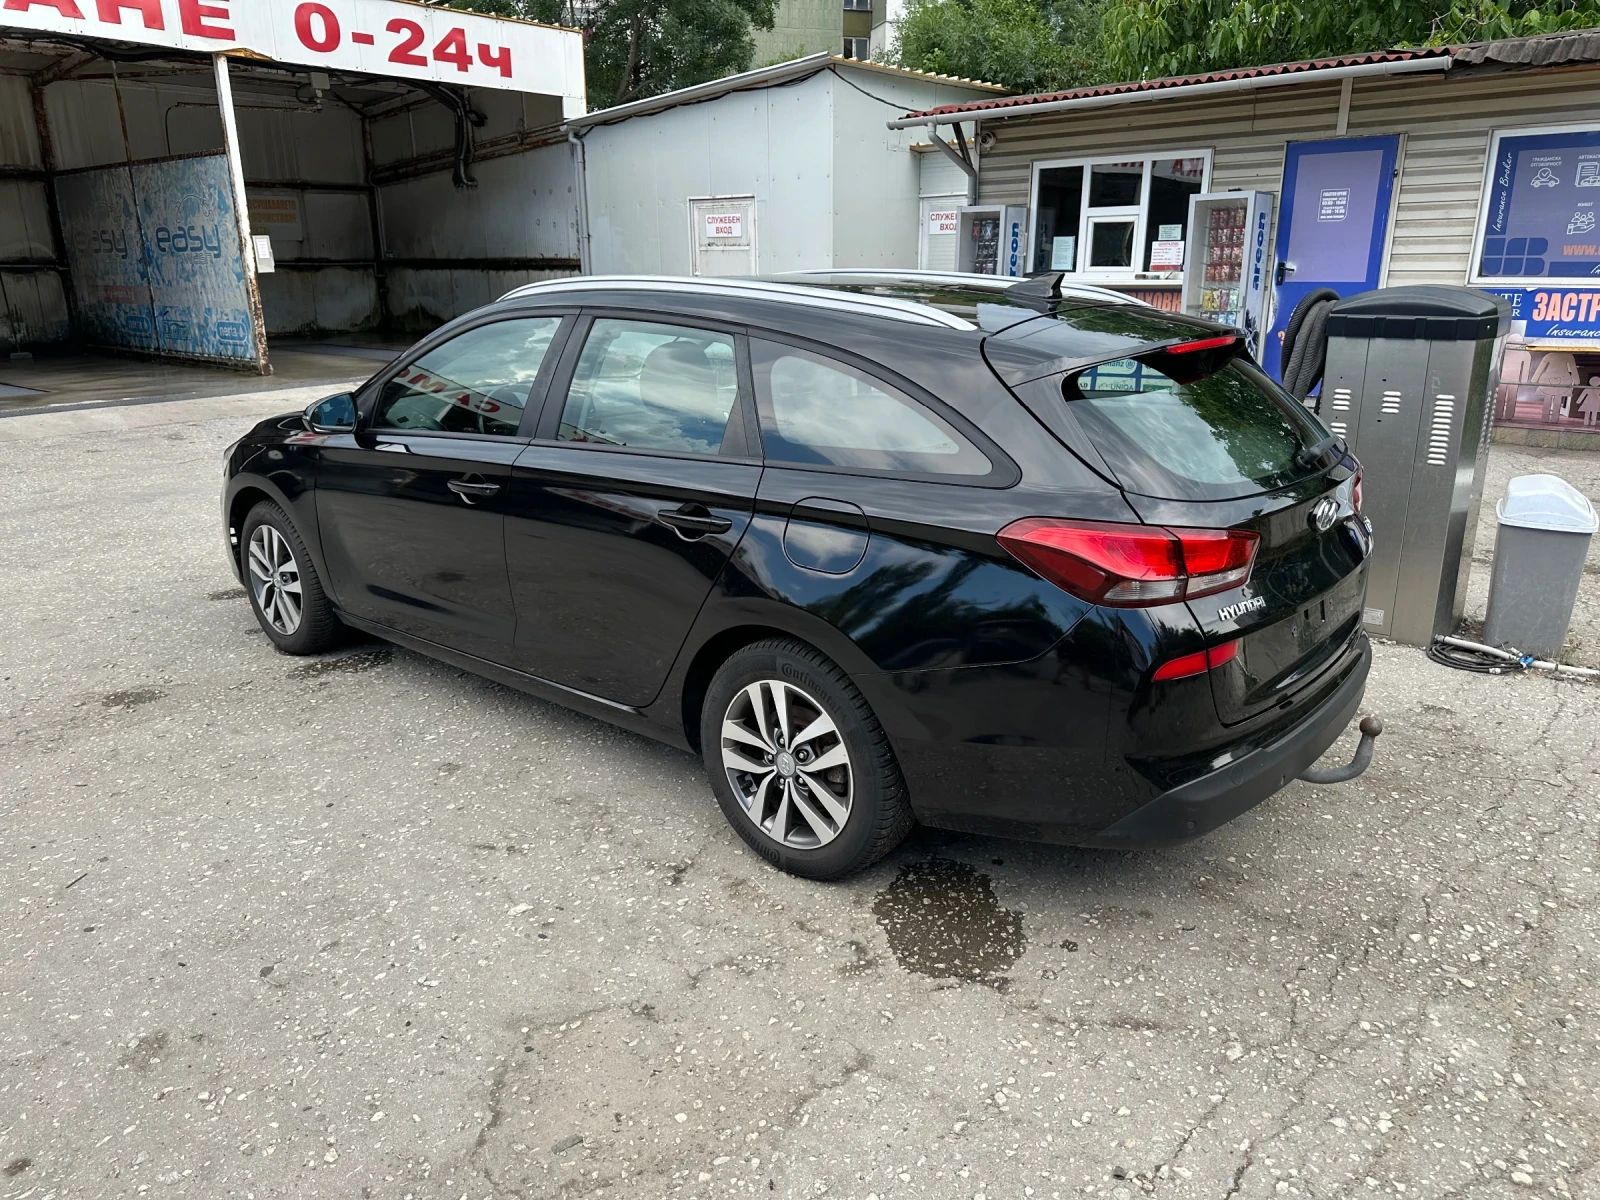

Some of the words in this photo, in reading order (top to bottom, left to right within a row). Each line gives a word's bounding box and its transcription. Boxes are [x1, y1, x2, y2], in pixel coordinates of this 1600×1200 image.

[1492, 190, 1506, 232] Insurance
[1499, 152, 1513, 187] Broker
[707, 216, 740, 224] СЛУЖЕБЕН
[930, 212, 957, 222] СЛУЖЕ
[156, 224, 222, 258] easy
[716, 226, 732, 235] ВХОД
[1253, 212, 1266, 290] areon
[1563, 244, 1600, 256] WWW.
[1218, 596, 1266, 621] HYUNDAI
[782, 663, 842, 716] Continental
